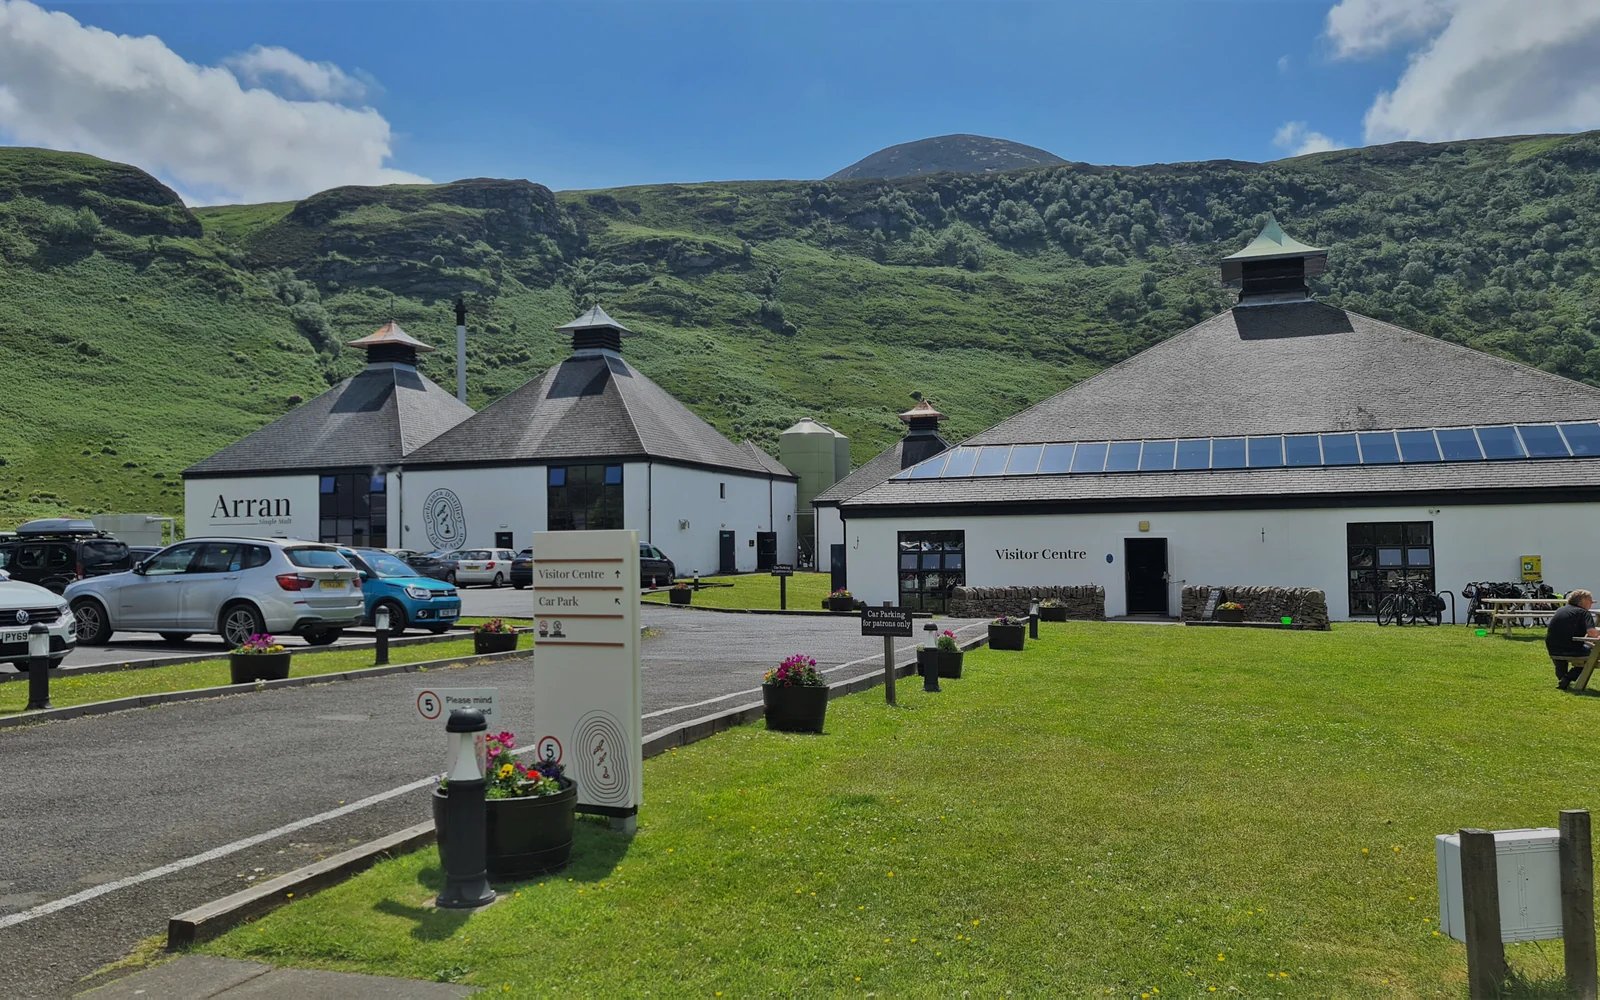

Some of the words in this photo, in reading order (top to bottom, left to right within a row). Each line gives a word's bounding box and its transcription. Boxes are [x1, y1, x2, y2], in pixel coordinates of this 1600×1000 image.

[210, 494, 292, 519] Arran
[444, 492, 463, 523] Distillery
[430, 533, 440, 545] Isle
[449, 532, 464, 548] Arran
[995, 548, 1039, 560] Visitor
[1041, 548, 1087, 560] Centre
[538, 569, 570, 579] Visitor
[571, 569, 605, 579] Centre
[538, 596, 556, 606] Car
[557, 595, 579, 606] Park
[867, 610, 880, 618] Car
[880, 610, 906, 620] Parking
[862, 619, 872, 627] for
[872, 620, 896, 629] patrons
[896, 619, 912, 630] only
[5, 632, 28, 641] PY69
[424, 698, 434, 712] 5
[445, 696, 471, 704] Please
[472, 695, 493, 704] mind
[546, 744, 555, 758] 5
